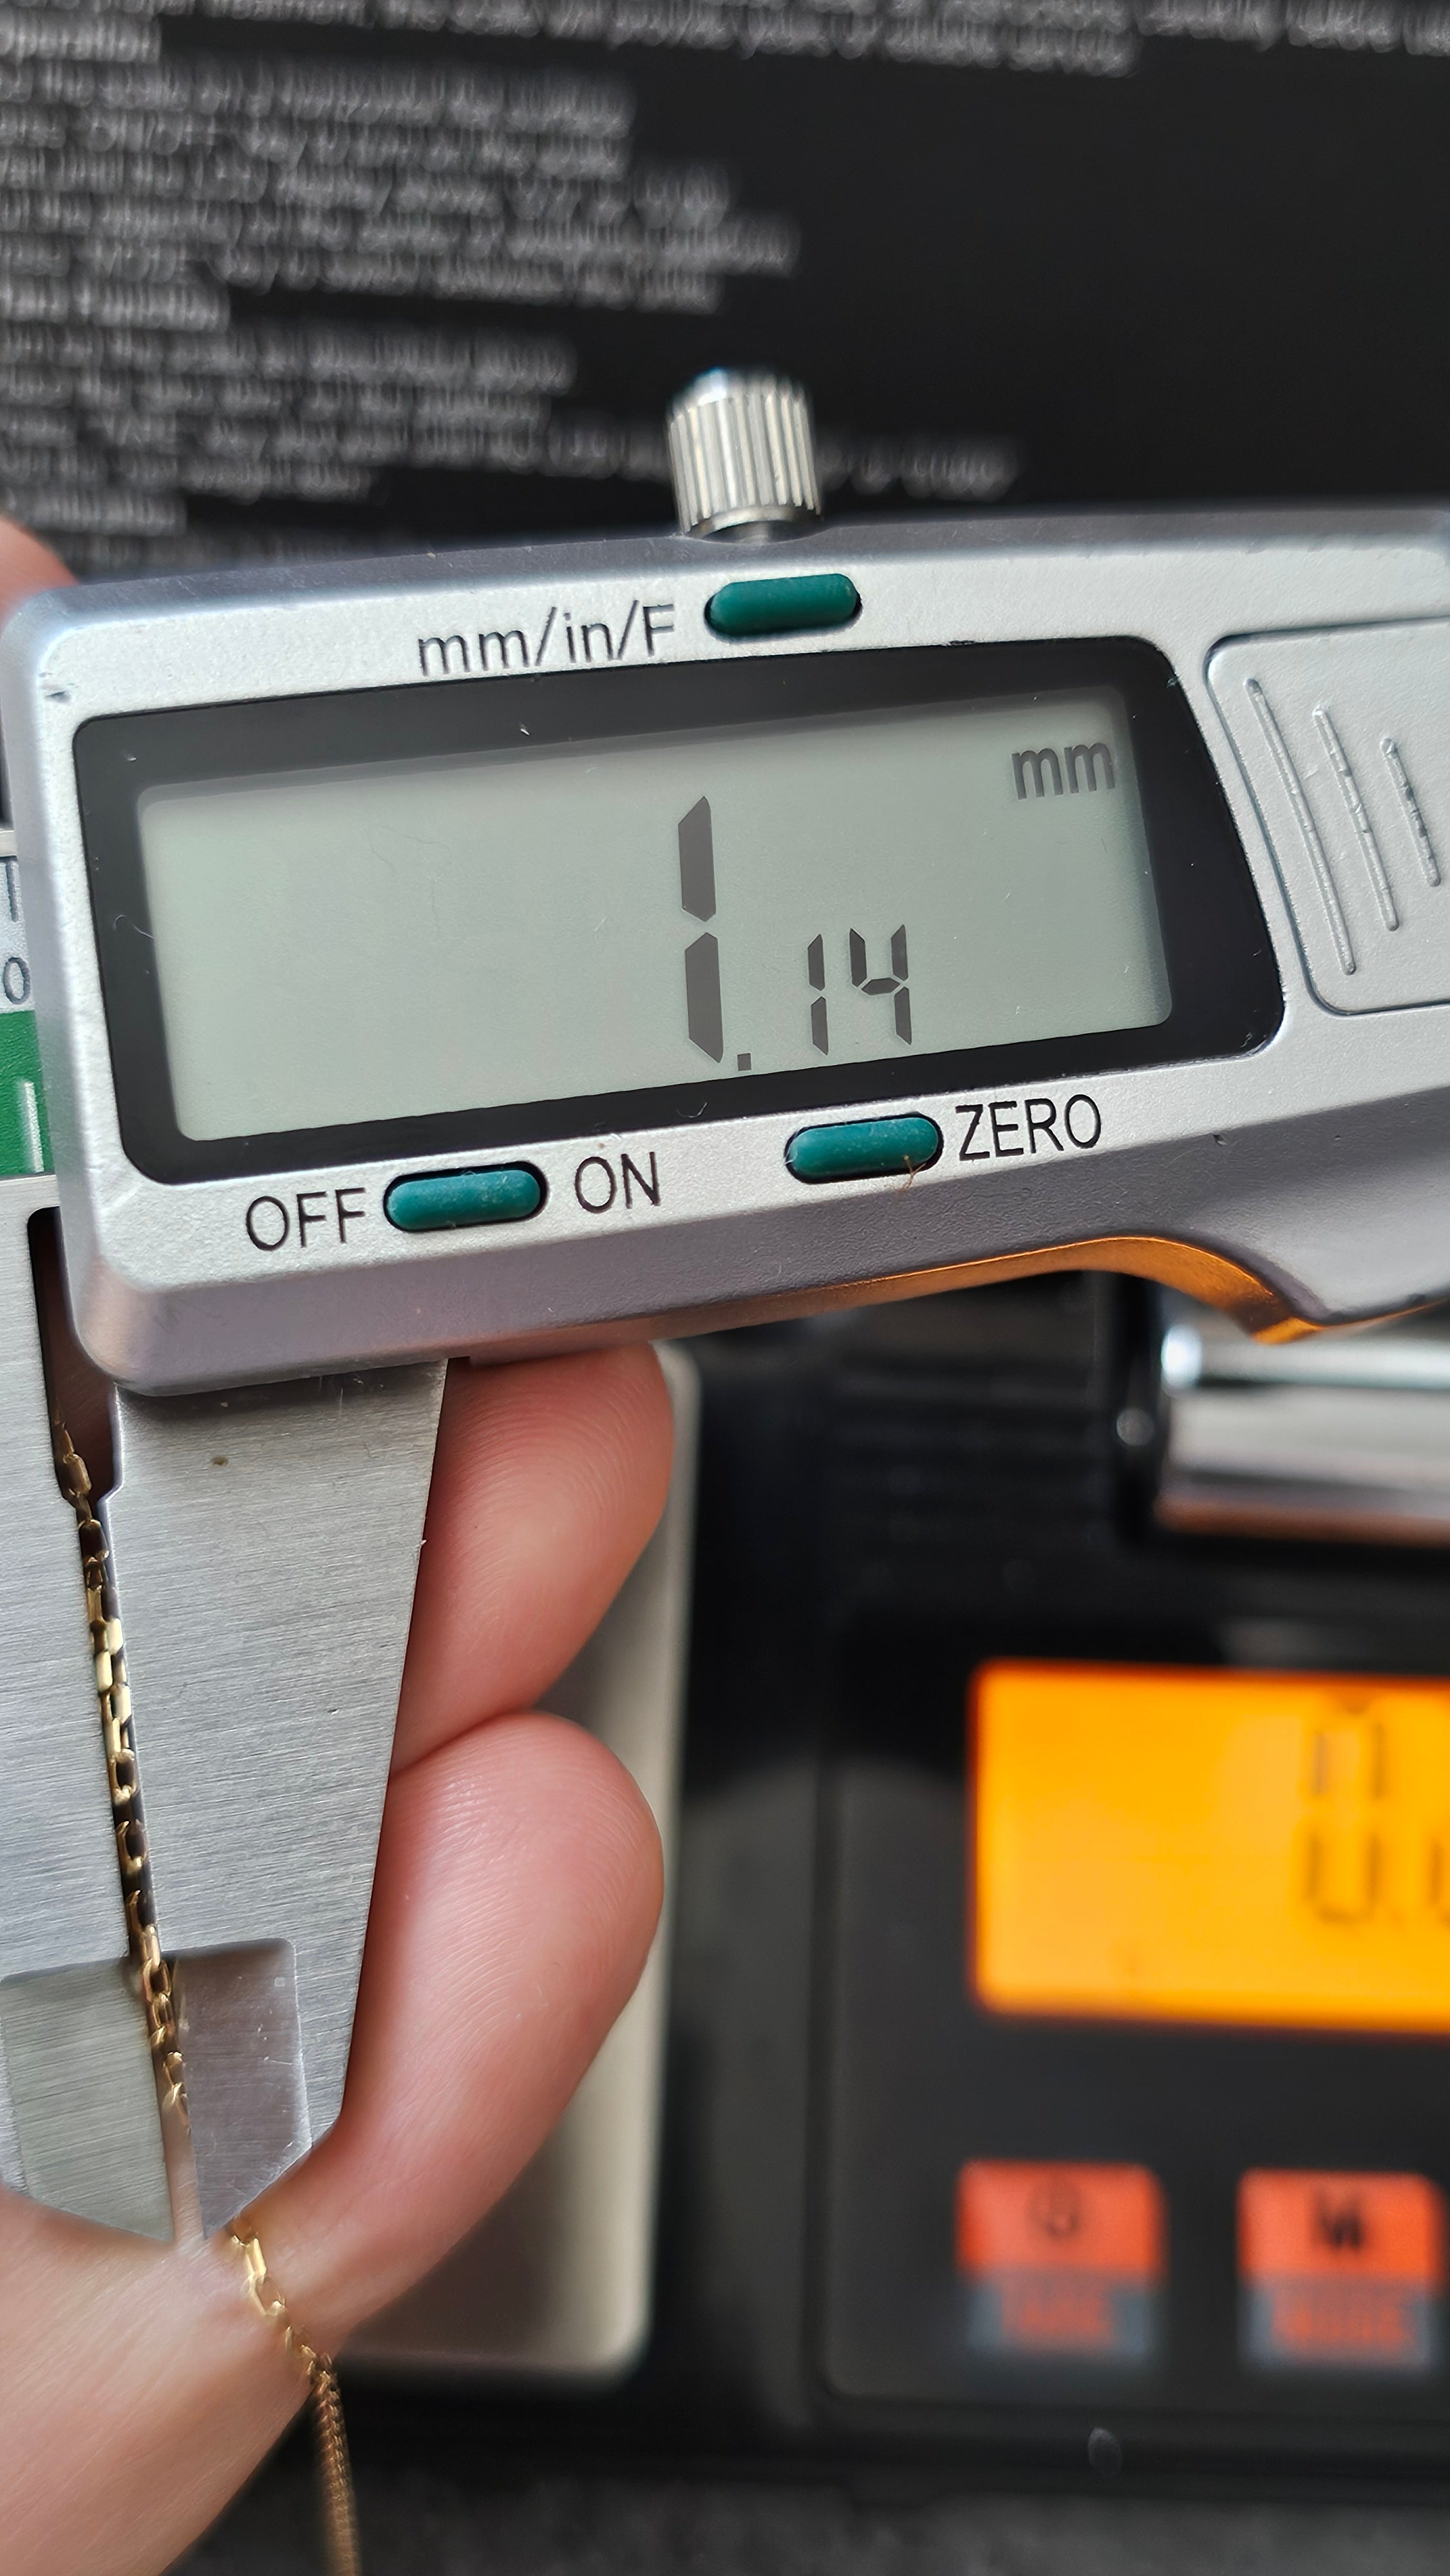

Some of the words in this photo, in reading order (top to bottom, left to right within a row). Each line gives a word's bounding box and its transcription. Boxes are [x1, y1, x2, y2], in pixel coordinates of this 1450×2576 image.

[418, 600, 674, 676] mm/in/F
[1012, 741, 1115, 800] mm
[677, 795, 912, 1072] 1.14
[956, 1094, 1102, 1162] ZERO
[574, 1151, 662, 1215] ON
[245, 1186, 367, 1251] OFF
